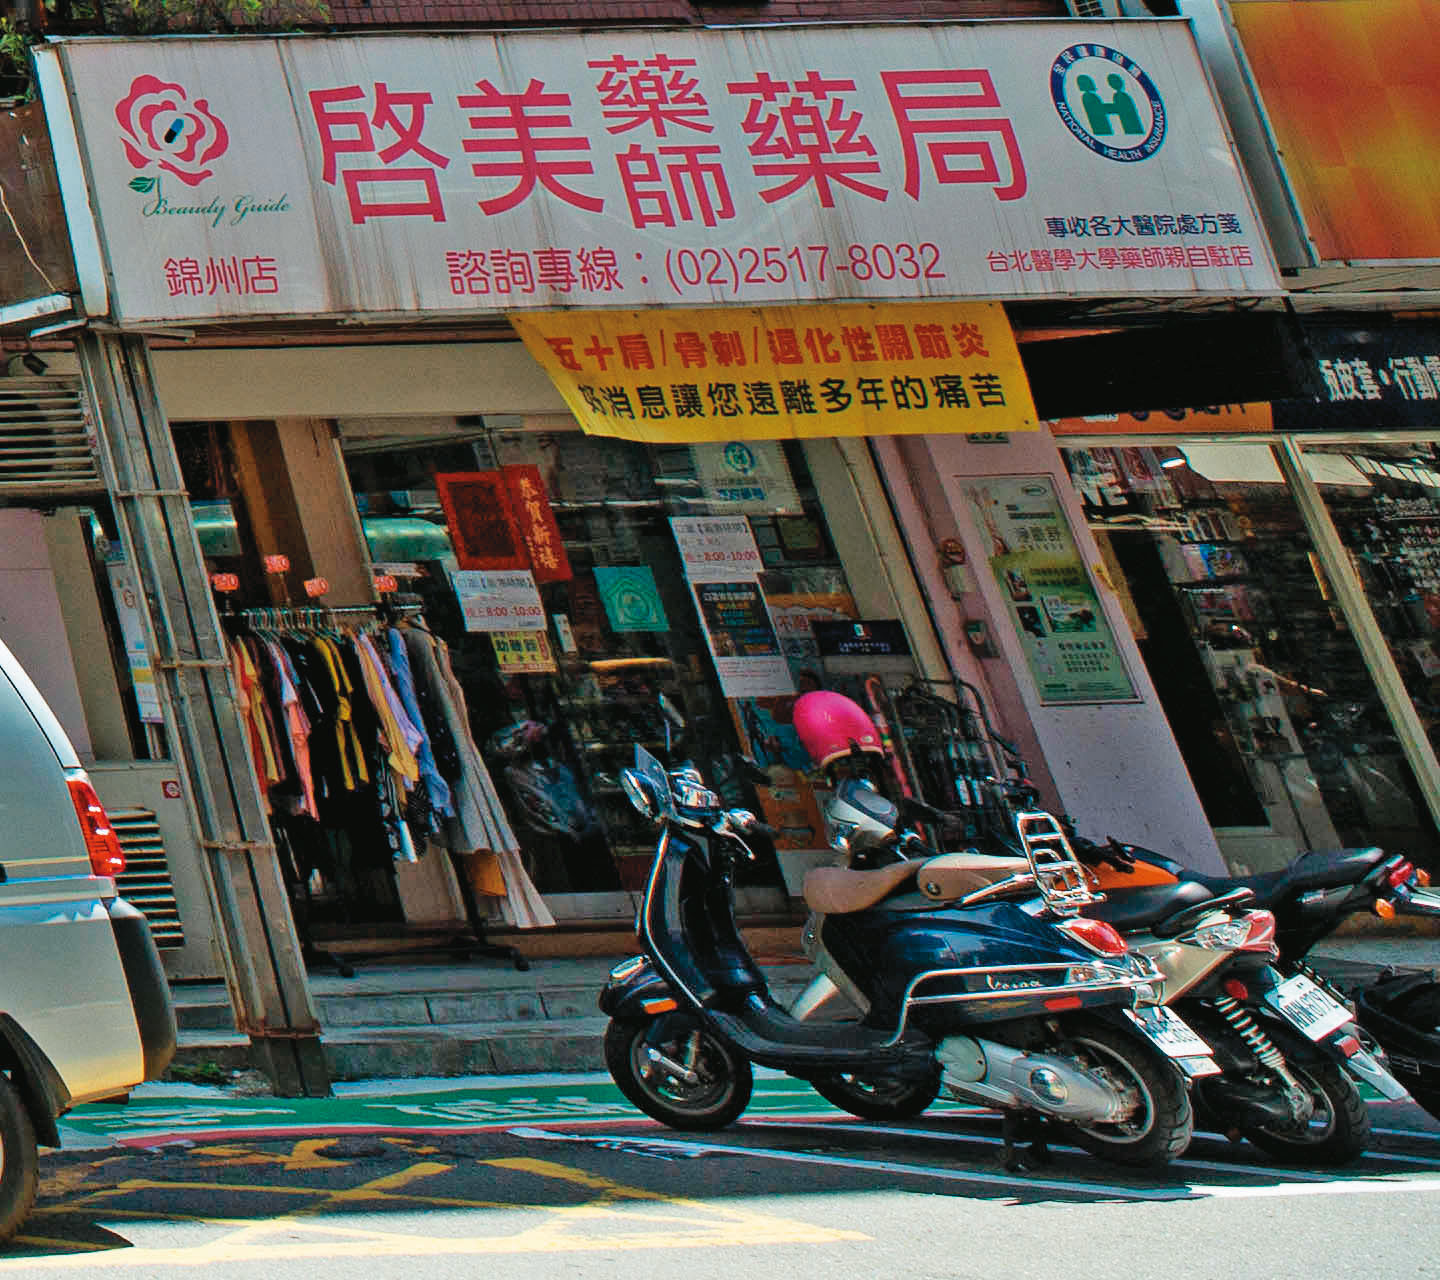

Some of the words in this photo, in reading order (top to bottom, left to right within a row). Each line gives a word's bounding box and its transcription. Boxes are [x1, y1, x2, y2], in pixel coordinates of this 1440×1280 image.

[1057, 101, 1097, 150] NATIONAL
[1103, 145, 1143, 162] HEALTH
[230, 192, 292, 227] Guide
[1043, 212, 1242, 239] 專收各大醫院處方箋
[163, 255, 279, 297] 錦州店
[665, 242, 947, 296] (02)2517-8032
[986, 244, 1254, 273] 台北醫學大學藥師親自駐店
[577, 373, 1007, 420] 好消息讓您遠離多年的痛苦
